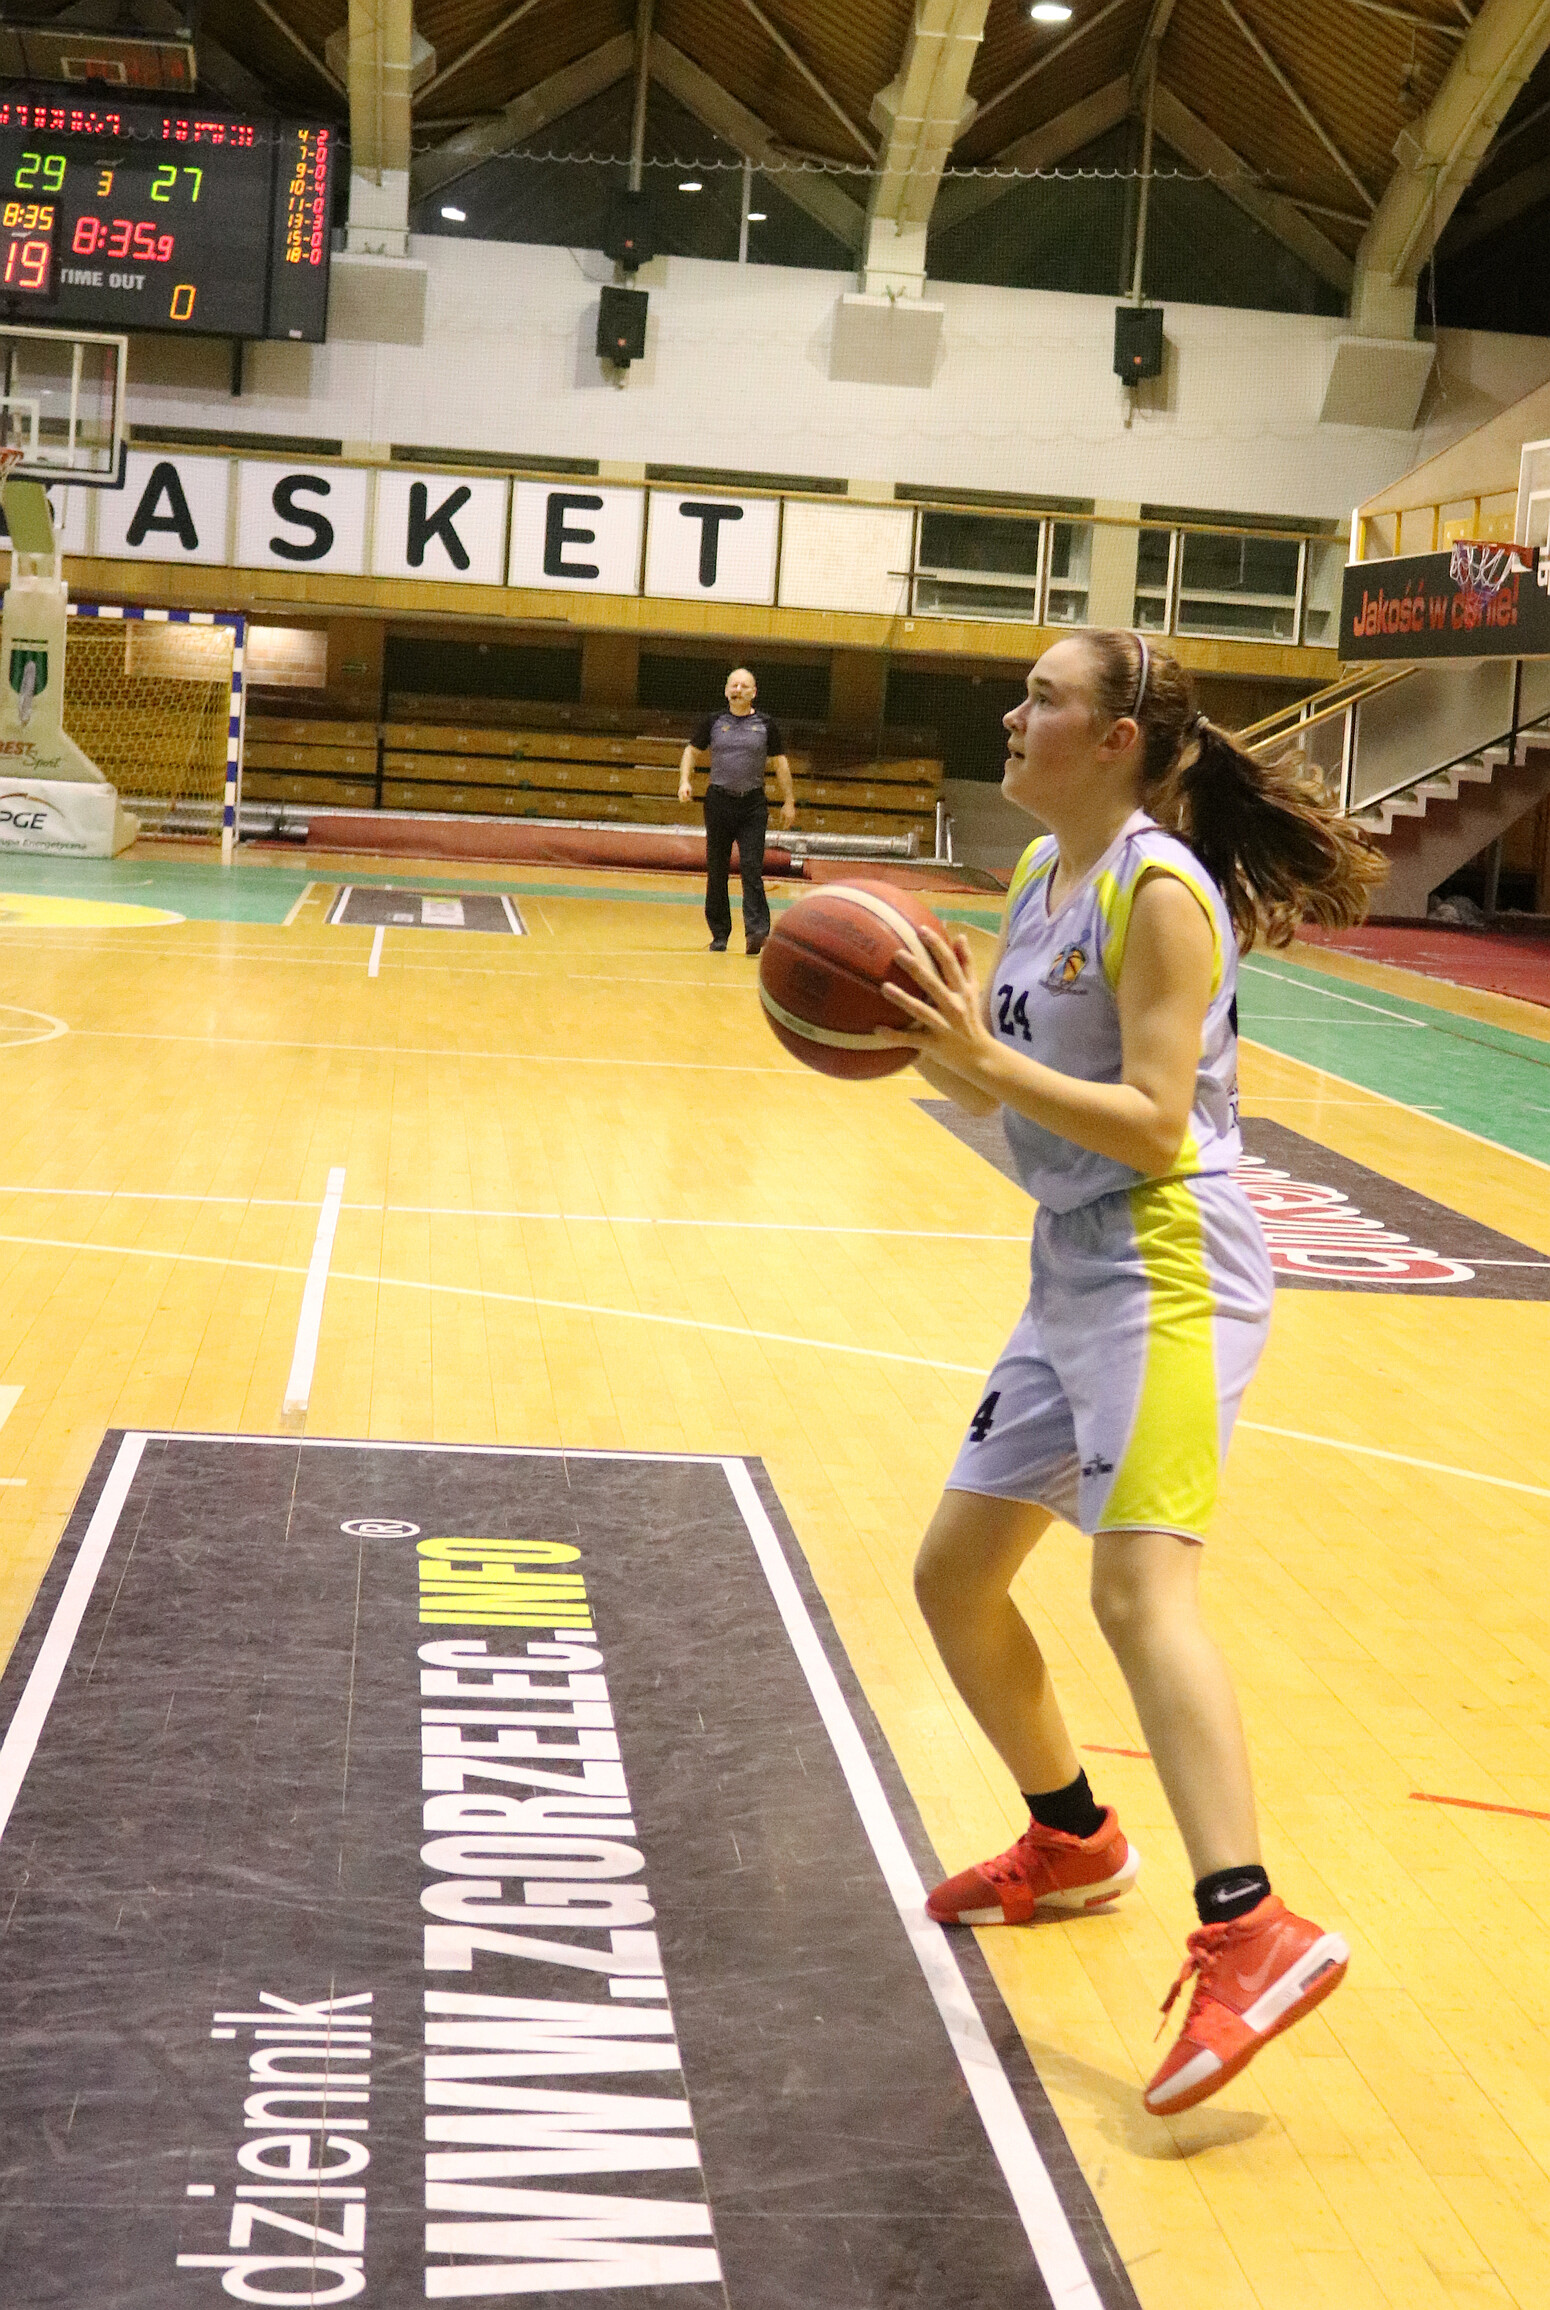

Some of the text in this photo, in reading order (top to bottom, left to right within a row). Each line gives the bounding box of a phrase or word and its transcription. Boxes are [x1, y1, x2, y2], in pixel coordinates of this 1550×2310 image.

[14, 152, 67, 191] 29
[97, 171, 114, 197] 3
[151, 164, 203, 202] 27
[3, 202, 54, 231] 8:35
[4, 241, 50, 288] 19
[60, 268, 147, 291] TIME OUT
[170, 284, 196, 320] 0
[0, 461, 744, 588] ASKET
[1353, 579, 1425, 637] Jakość
[1429, 596, 1448, 630] w
[997, 983, 1033, 1042] 24
[416, 1537, 723, 2299] WWW.ZGORZELEC.INFO
[176, 1991, 373, 2306] dziennik
